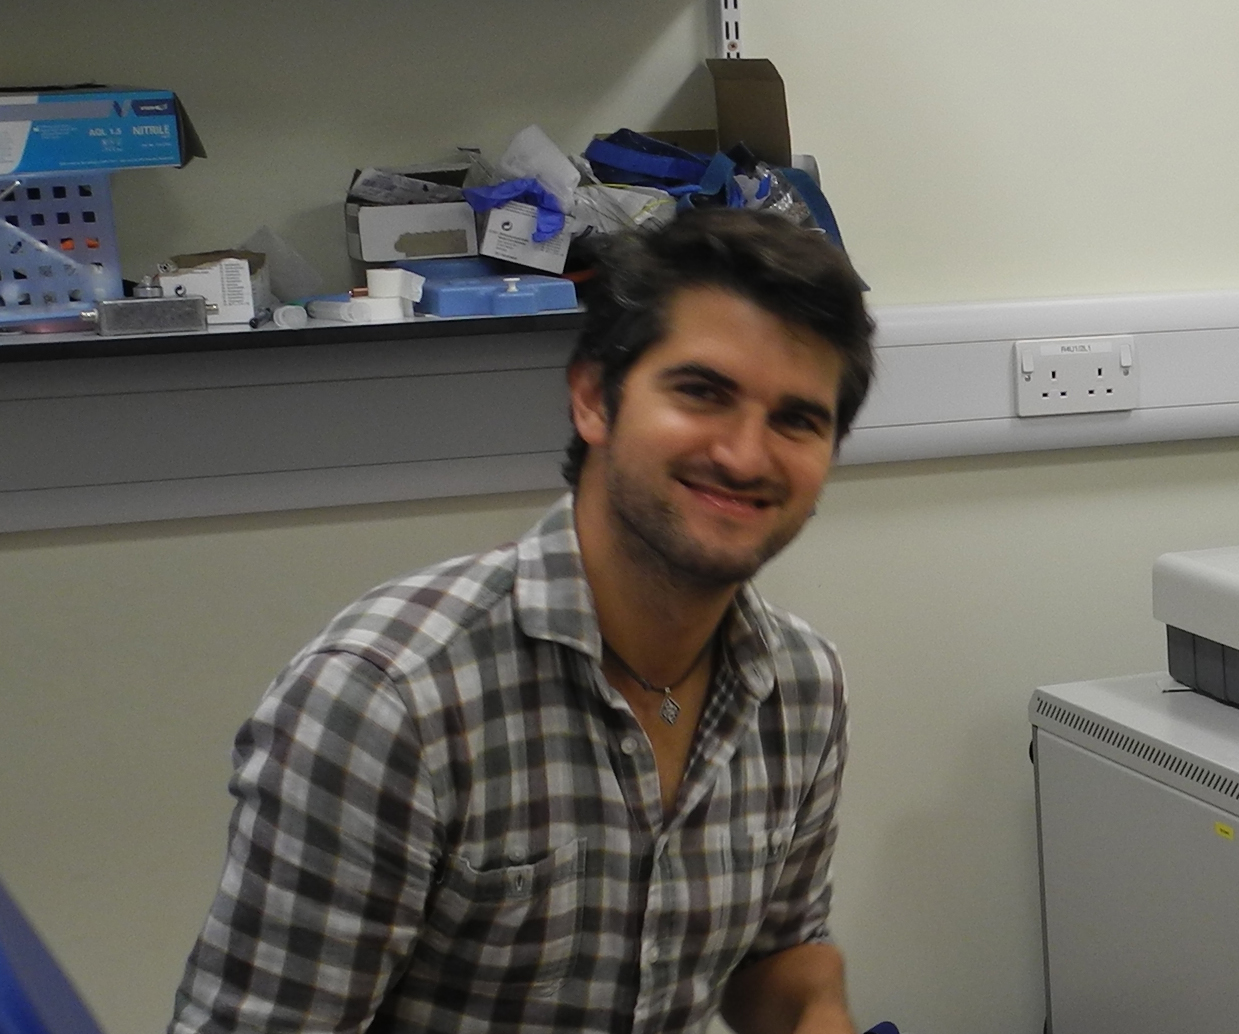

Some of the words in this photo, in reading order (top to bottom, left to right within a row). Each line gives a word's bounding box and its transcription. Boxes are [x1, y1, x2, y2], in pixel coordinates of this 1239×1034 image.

[88, 128, 107, 137] AQL
[109, 127, 122, 136] 1.5
[131, 124, 171, 136] NITRILE
